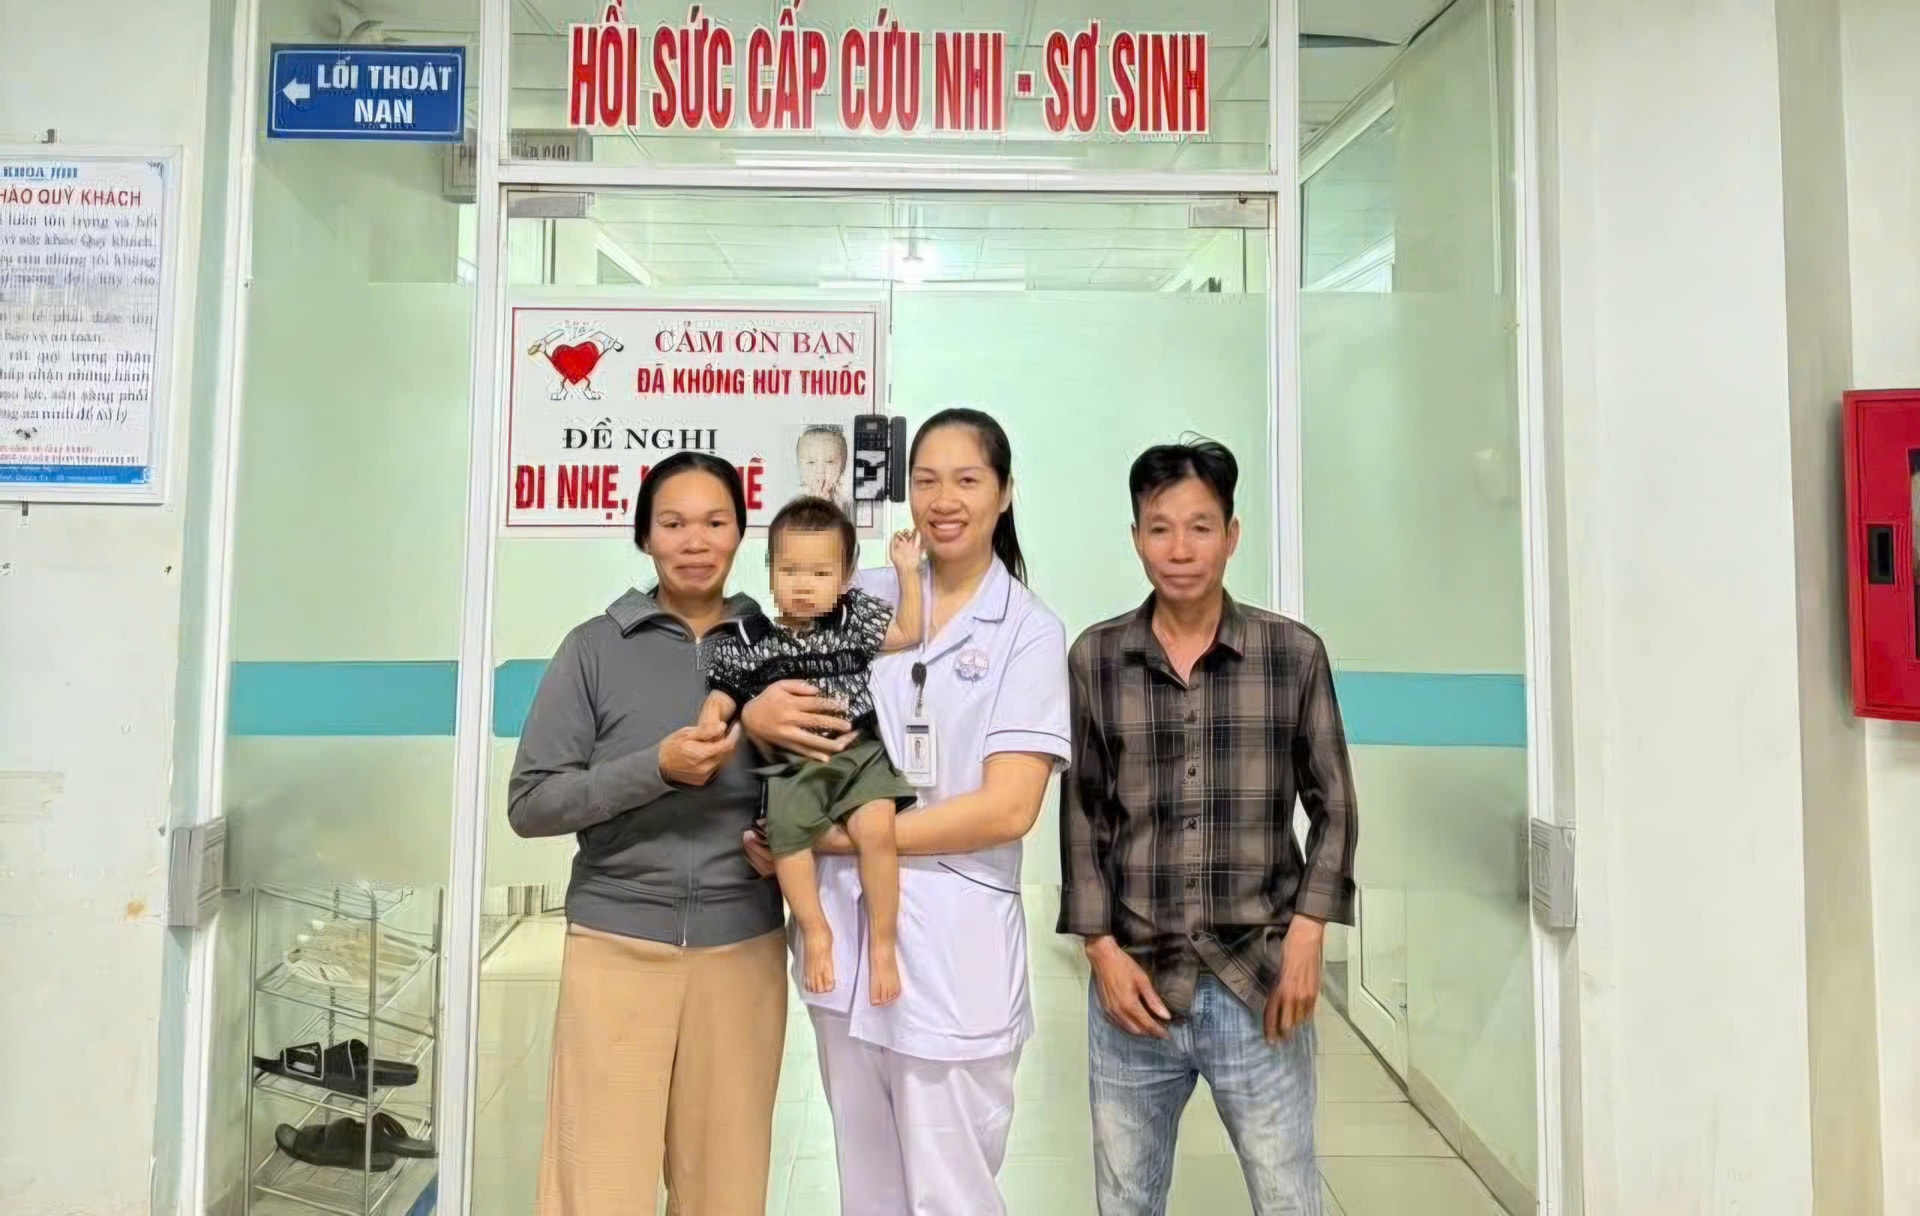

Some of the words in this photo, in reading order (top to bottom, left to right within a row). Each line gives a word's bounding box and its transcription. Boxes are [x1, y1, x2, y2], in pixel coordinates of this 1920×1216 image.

[317, 55, 359, 89] LỐI
[571, 0, 637, 128] HỒI
[652, 5, 733, 128] SỨC
[748, 0, 827, 129] CẤP
[841, 8, 921, 131] CỨU
[935, 32, 1002, 131] NHI
[1044, 22, 1099, 132] SƠ
[1110, 32, 1206, 132] SINH
[354, 97, 414, 129] NẠN
[655, 321, 723, 353] CẢM
[793, 331, 856, 360] BẠN
[637, 363, 665, 394] ĐÃ
[673, 363, 744, 394] KHÔNG
[752, 364, 792, 395] HÚT
[799, 361, 866, 396] THUỐC
[562, 417, 613, 450] ĐỀ
[625, 428, 719, 455] NGHỊ
[515, 464, 546, 509] ĐI
